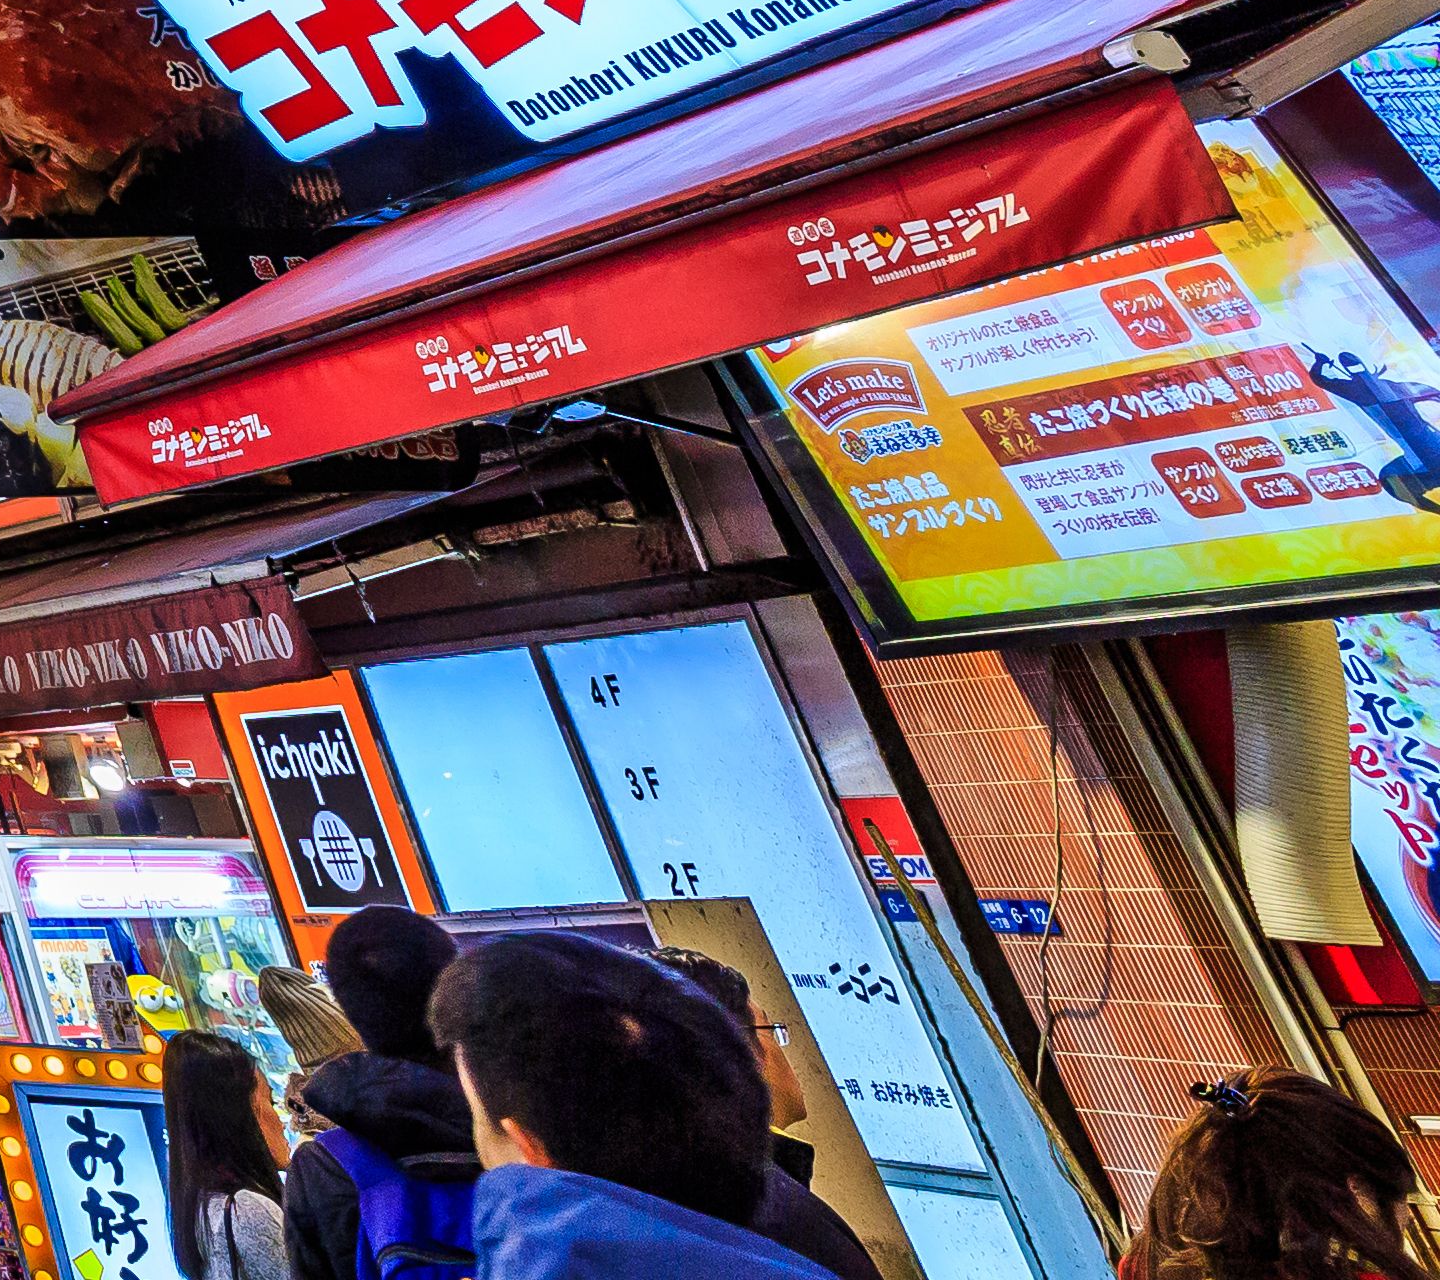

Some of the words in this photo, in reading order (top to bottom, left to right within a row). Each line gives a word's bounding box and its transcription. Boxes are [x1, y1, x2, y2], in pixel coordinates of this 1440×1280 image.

[511, 56, 628, 127] Dotonbori
[634, 7, 734, 84] KUKURU
[797, 193, 1031, 286] コナモンミュージアム
[1112, 292, 1163, 316] サンプル
[1176, 276, 1232, 303] オリジナル
[1128, 314, 1167, 336] づくり
[1196, 298, 1251, 326] はちまき
[926, 309, 1059, 352] オリジナルのたこ焼食品
[423, 325, 588, 393] コナモンミュージアム
[802, 376, 845, 409] Let's
[848, 369, 905, 393] make
[1243, 370, 1303, 398] ¥4,000
[152, 413, 272, 464] コナモンミュージアム
[1287, 429, 1348, 455] 忍者登場
[1164, 459, 1218, 484] サンプル
[1253, 475, 1298, 501] たこ焼
[1310, 467, 1376, 494] 記念写真
[849, 472, 949, 510] たこ焼食品
[1037, 480, 1165, 516] 登場して食品サンプル
[1181, 481, 1220, 507] づくり
[867, 497, 1003, 538] サンプルづくり
[150, 612, 294, 674] NIKO-NIKO
[590, 672, 622, 707] 4F
[624, 766, 660, 802] 3F
[663, 862, 700, 897] 2F
[1010, 904, 1050, 927] 6-12
[792, 972, 829, 991] HOUSE
[829, 962, 900, 1005] ニコニコ
[872, 1079, 954, 1110] お好み焼き
[67, 1109, 156, 1280] お好
